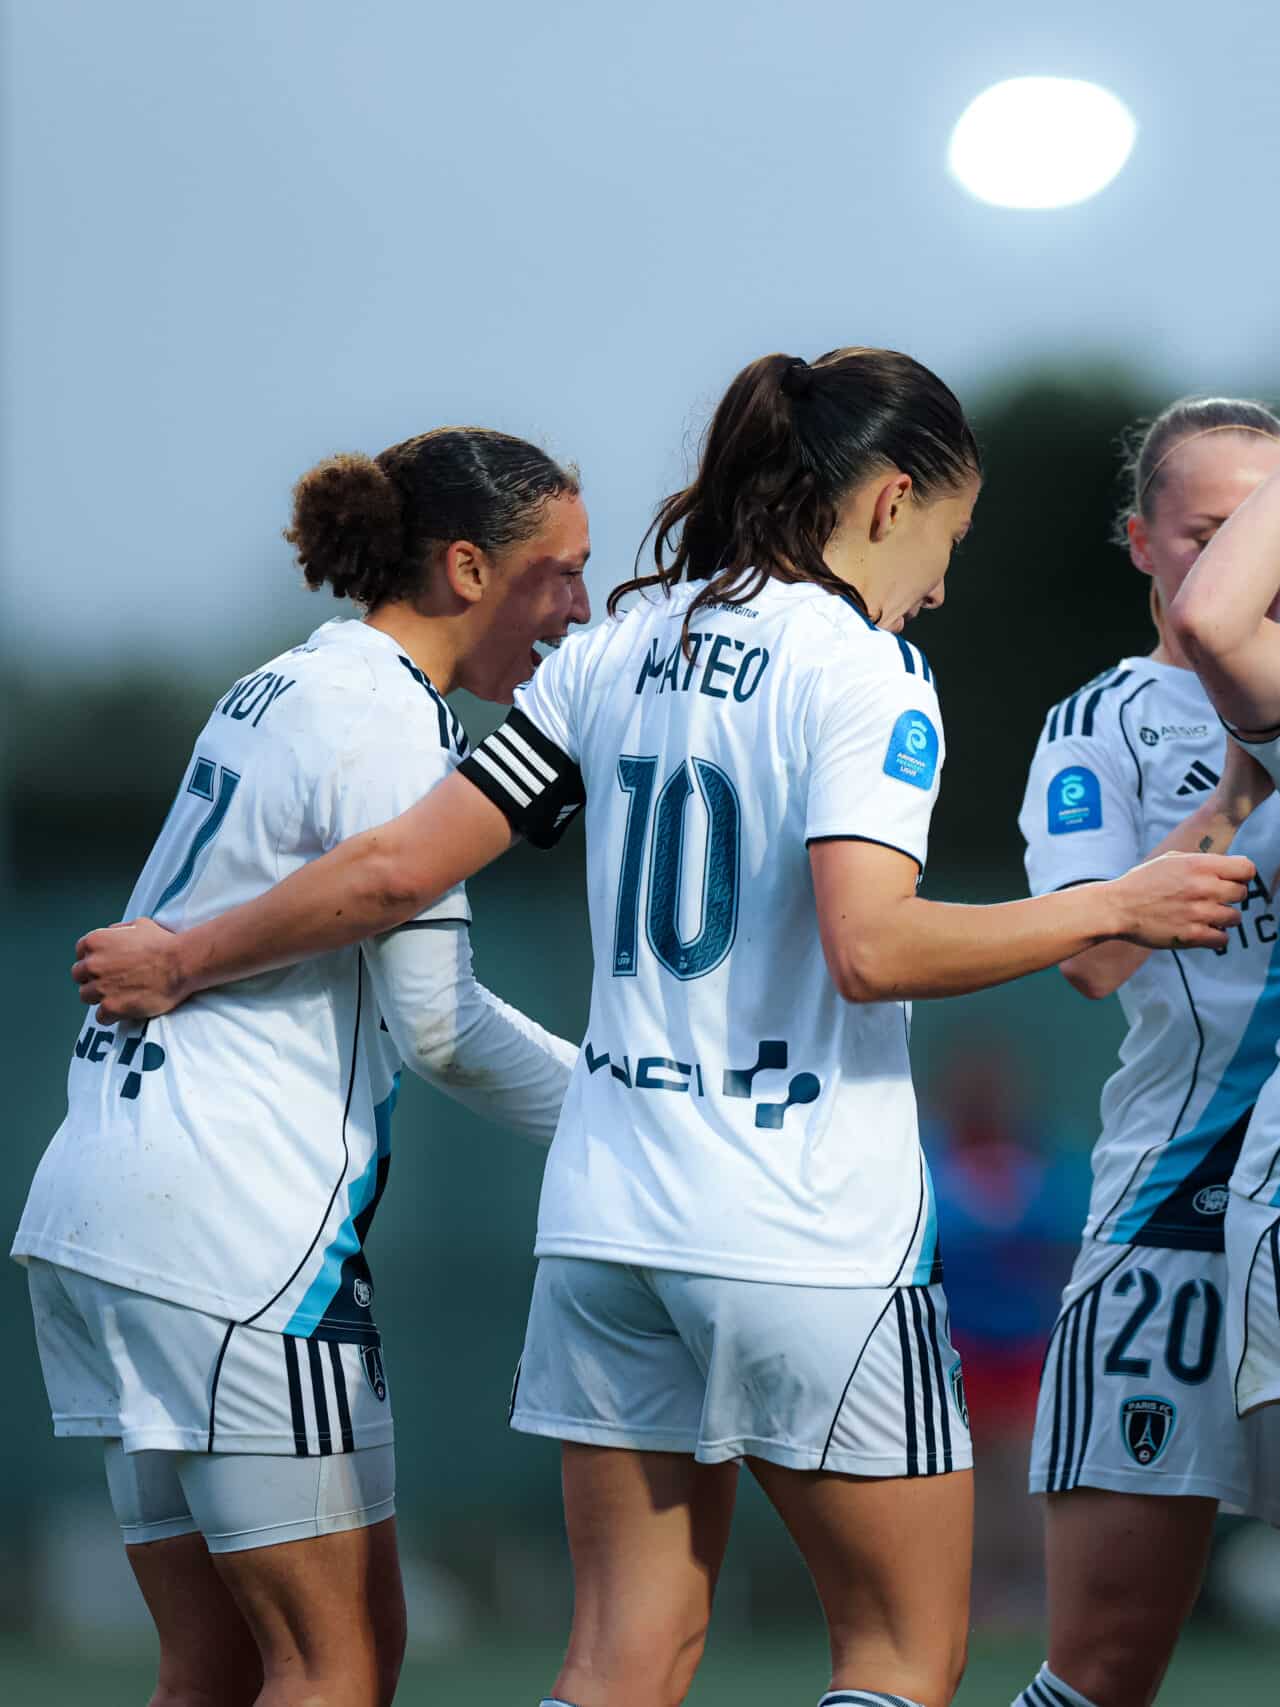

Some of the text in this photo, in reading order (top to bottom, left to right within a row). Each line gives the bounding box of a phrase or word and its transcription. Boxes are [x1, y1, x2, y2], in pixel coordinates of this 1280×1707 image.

[635, 632, 770, 703] MATEO
[151, 756, 241, 919] 7
[613, 754, 741, 981] 10
[1104, 1267, 1224, 1386] 20
[1128, 1401, 1171, 1414] PARIS FC
